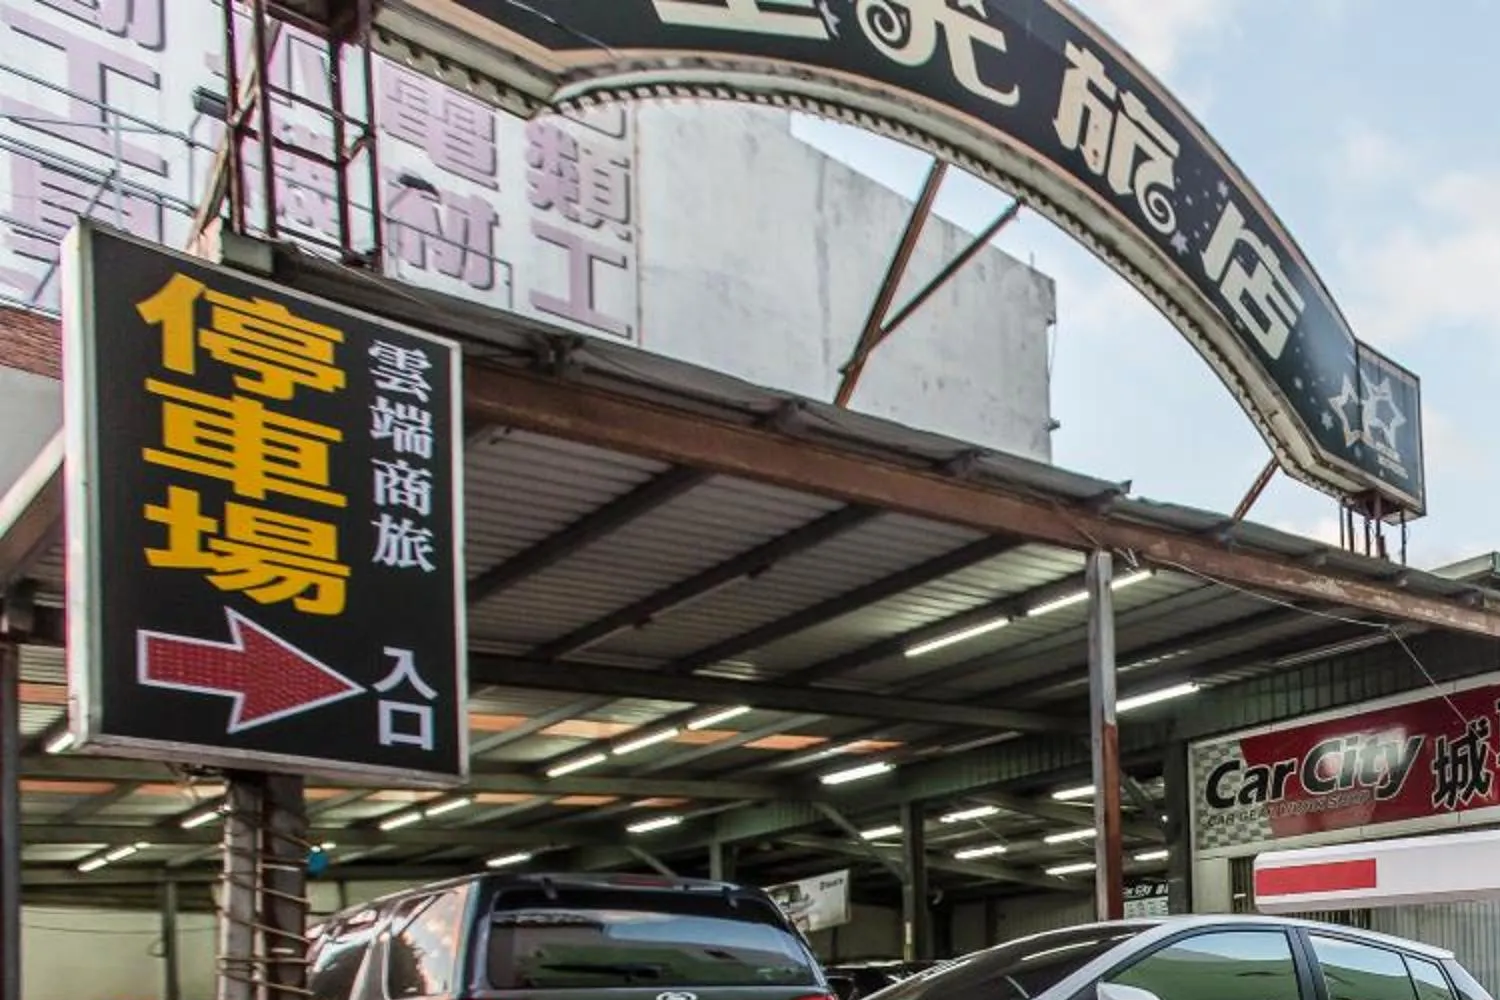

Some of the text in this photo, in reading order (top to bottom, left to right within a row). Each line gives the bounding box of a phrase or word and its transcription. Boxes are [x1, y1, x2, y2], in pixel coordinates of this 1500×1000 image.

[136, 272, 351, 616] 停車場
[369, 339, 437, 574] 雲端商旅
[373, 646, 438, 752] 入口
[1205, 729, 1424, 809] Car City
